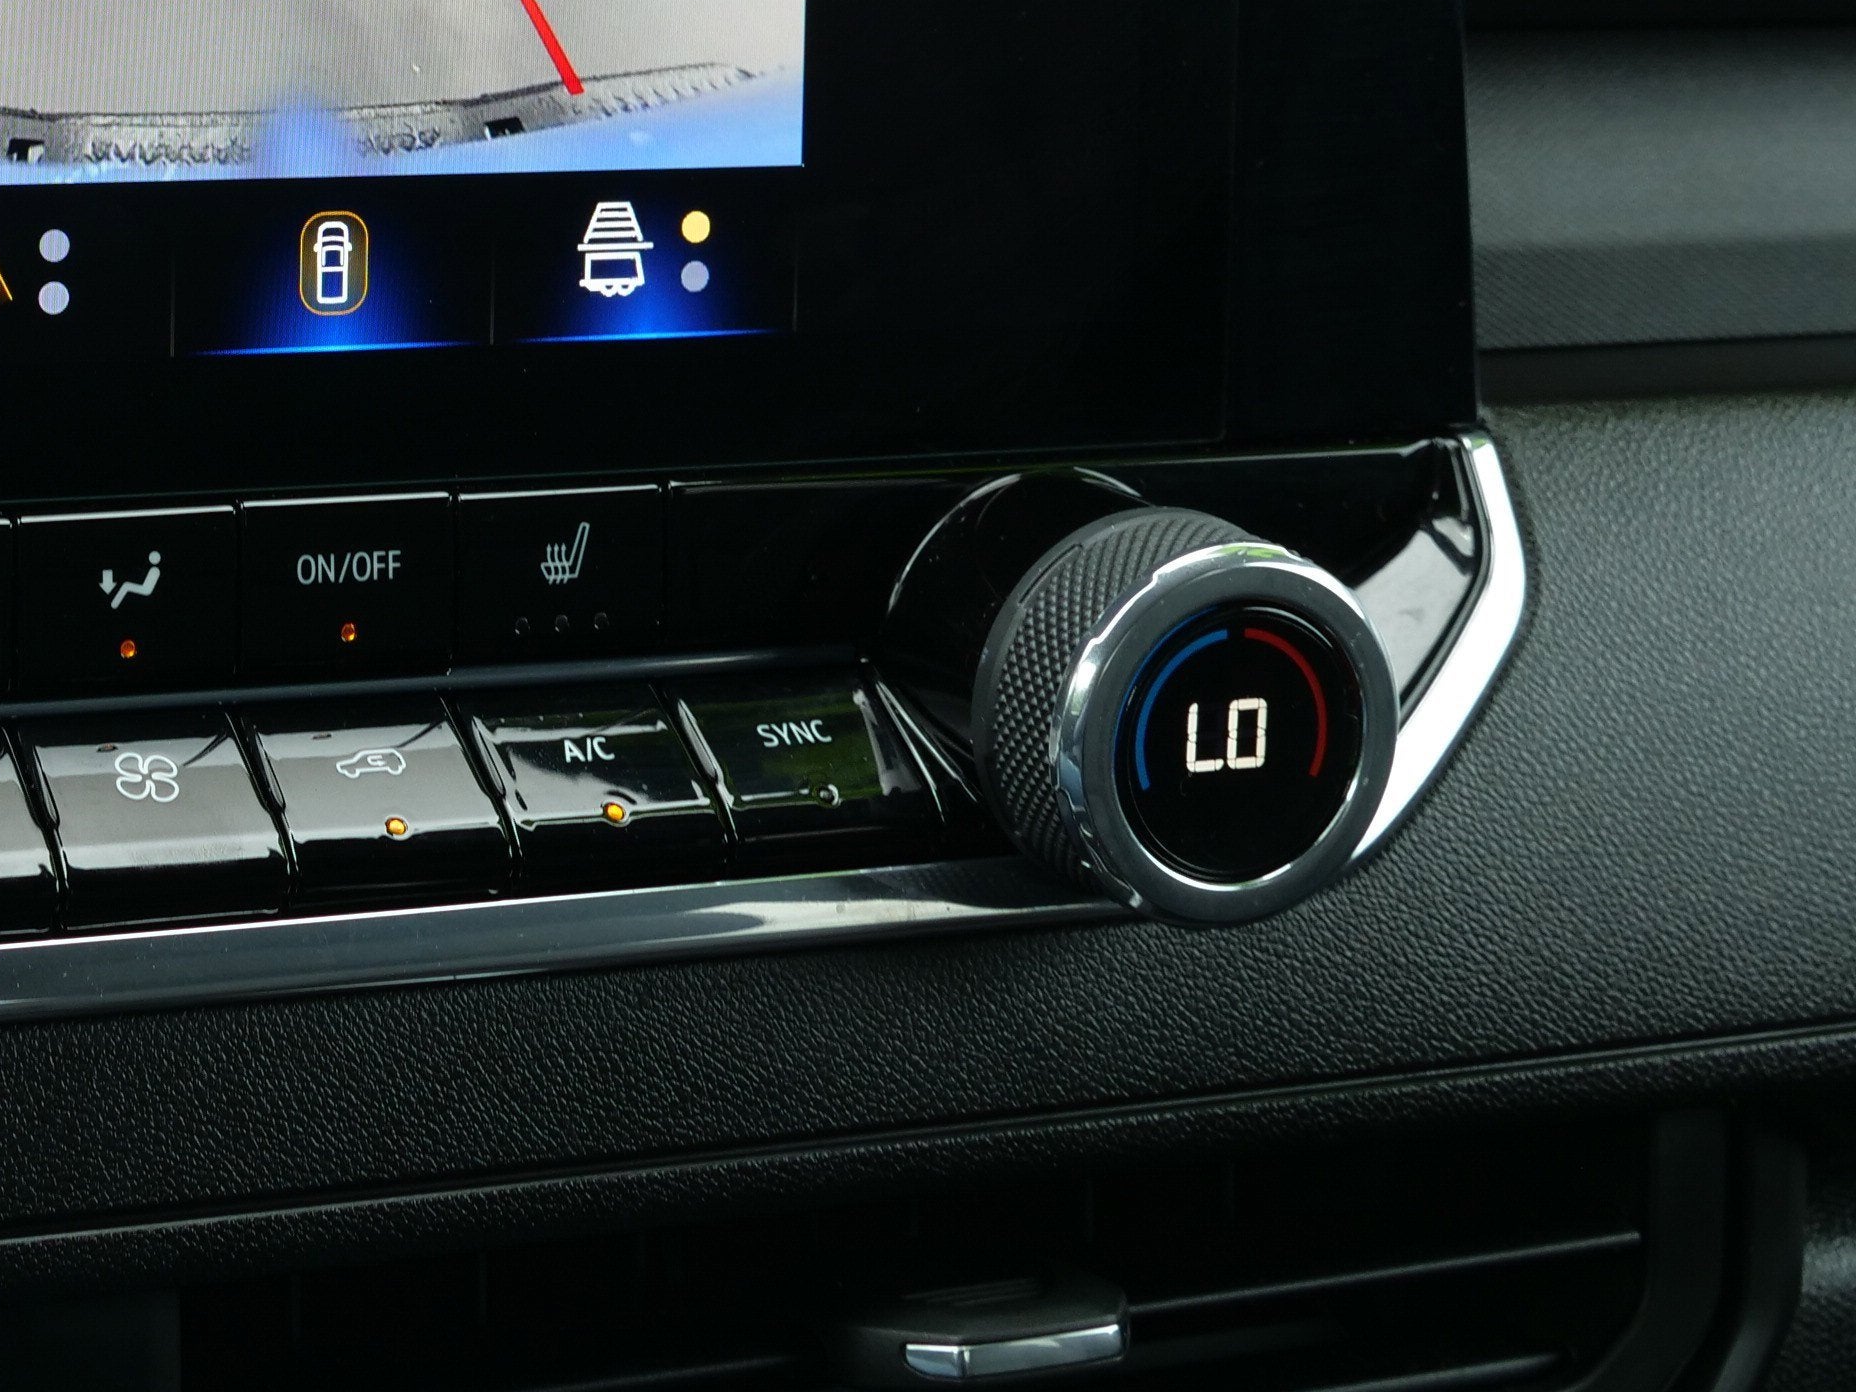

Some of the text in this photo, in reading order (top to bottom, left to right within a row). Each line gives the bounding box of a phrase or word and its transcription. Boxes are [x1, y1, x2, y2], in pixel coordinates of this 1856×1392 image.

[296, 549, 402, 586] ON/OFF
[563, 734, 616, 764] A/C
[756, 719, 833, 748] SYNC
[1186, 697, 1268, 773] LO
